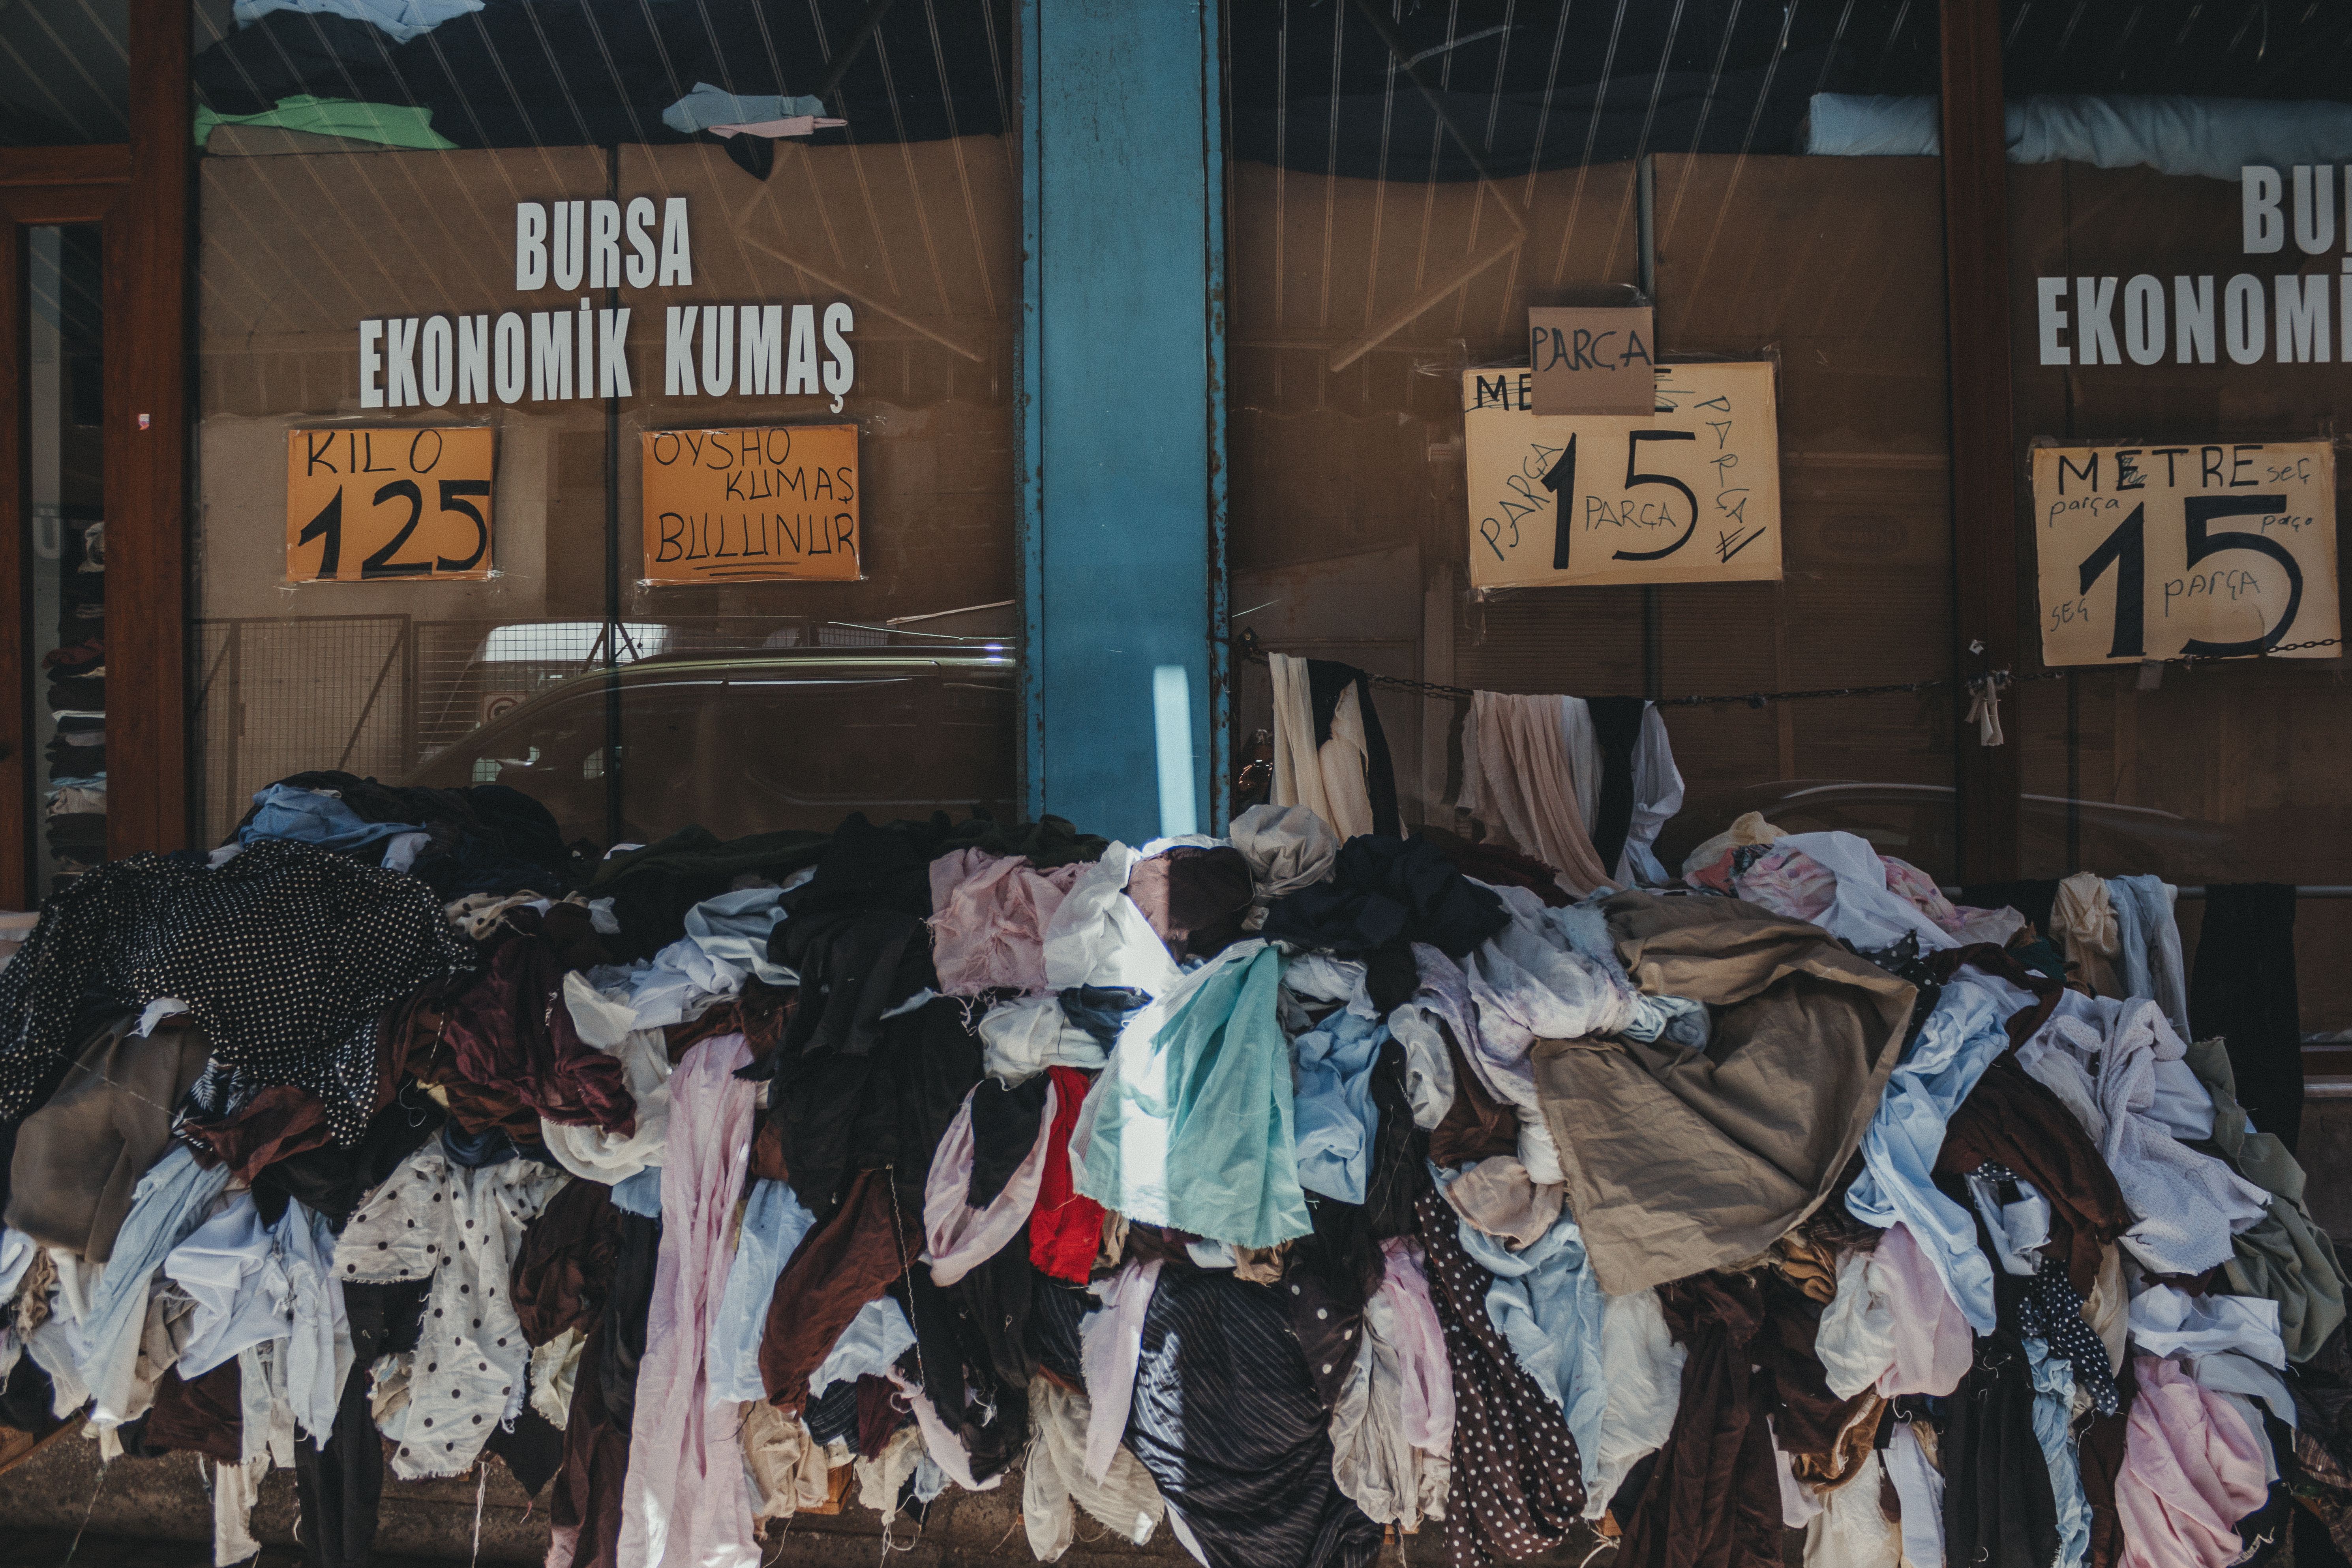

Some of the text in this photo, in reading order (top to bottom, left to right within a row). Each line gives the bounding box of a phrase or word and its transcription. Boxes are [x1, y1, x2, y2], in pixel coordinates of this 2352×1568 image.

[2241, 164, 2352, 255] BU
[516, 197, 692, 291] BURSA
[360, 297, 853, 414] EKONOMİK KUMAŞ
[308, 429, 443, 476] KILO
[654, 428, 791, 470] OYSHO
[2058, 445, 2264, 495] METRE
[726, 466, 854, 504] KUMAŞ
[1540, 430, 1698, 570] 15
[298, 479, 491, 580] 125
[655, 512, 855, 563] BULUNUR
[1585, 495, 1676, 532] PARÇA
[2049, 497, 2120, 528] parça
[2078, 494, 2304, 659] 15
